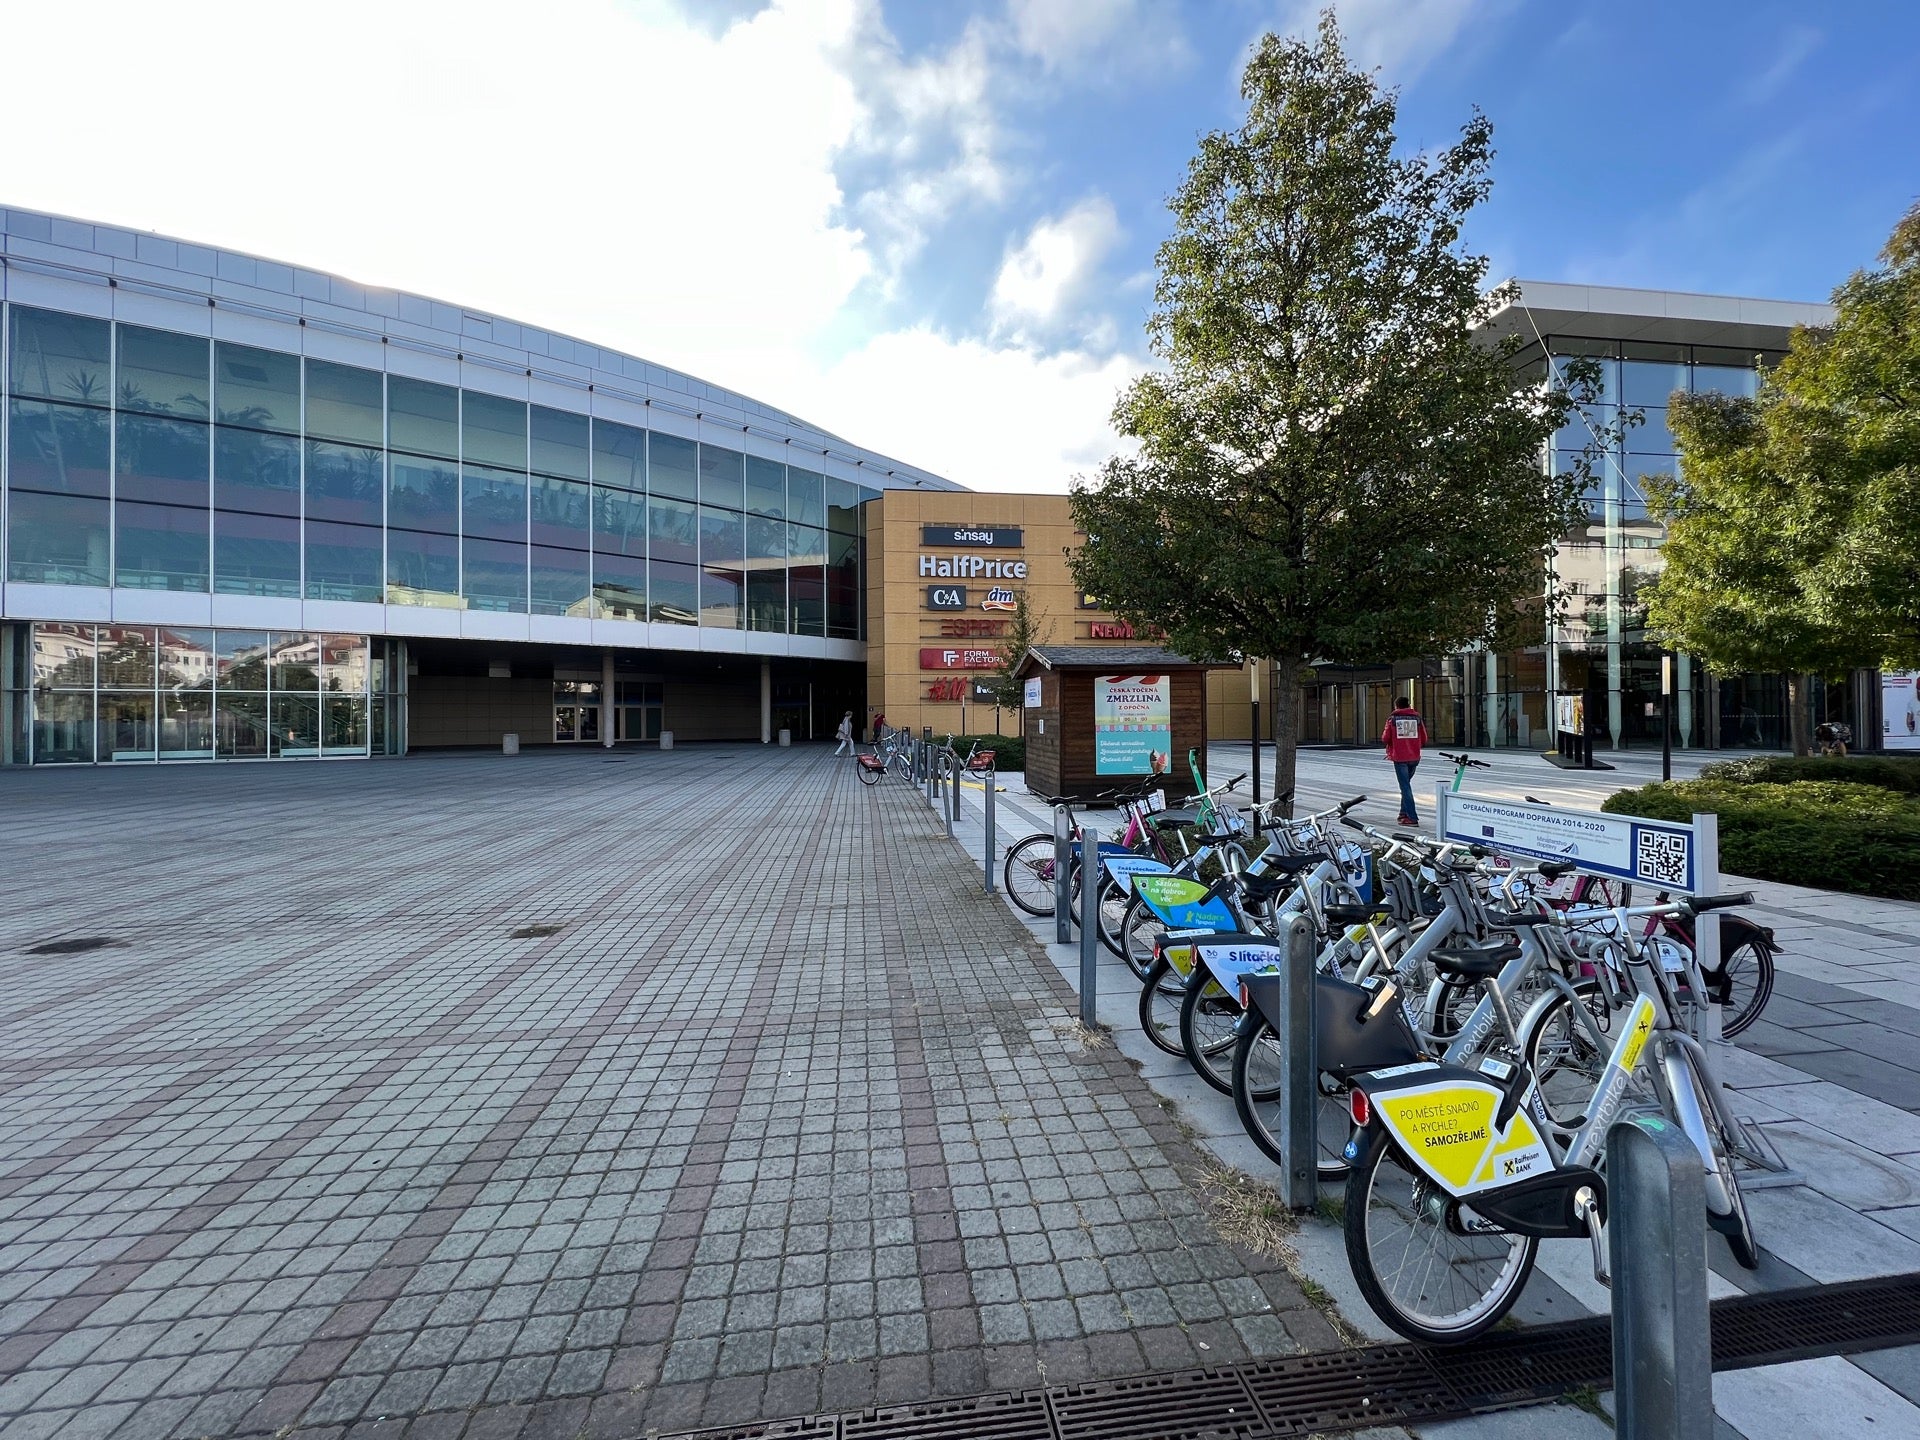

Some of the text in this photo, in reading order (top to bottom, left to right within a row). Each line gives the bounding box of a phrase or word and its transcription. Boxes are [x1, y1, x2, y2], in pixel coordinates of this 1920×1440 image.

[953, 528, 994, 545] sinsay
[919, 555, 1027, 578] HalfPrice
[933, 589, 962, 605] C&A
[988, 587, 1013, 602] dm
[941, 618, 1010, 637] ESPRIT
[928, 676, 968, 703] H&M
[1106, 694, 1162, 703] ZMRZLINA
[1493, 808, 1525, 820] PROGRAM
[1526, 813, 1561, 825] DOPRAVA
[1562, 818, 1606, 832] 2014-2020
[1161, 886, 1187, 896] dobrou
[1195, 912, 1225, 921] Nadace
[1457, 1006, 1498, 1064] nextbik
[1400, 1100, 1480, 1120] PO MĚSTĚ SNADNO
[1584, 1075, 1628, 1158] nextbike
[1412, 1119, 1458, 1134] A RYCHLE?
[1425, 1126, 1488, 1148] SAMOZŘEJMĚ.
[1514, 1152, 1540, 1165] Raiffeisen
[1516, 1162, 1532, 1174] BANK
